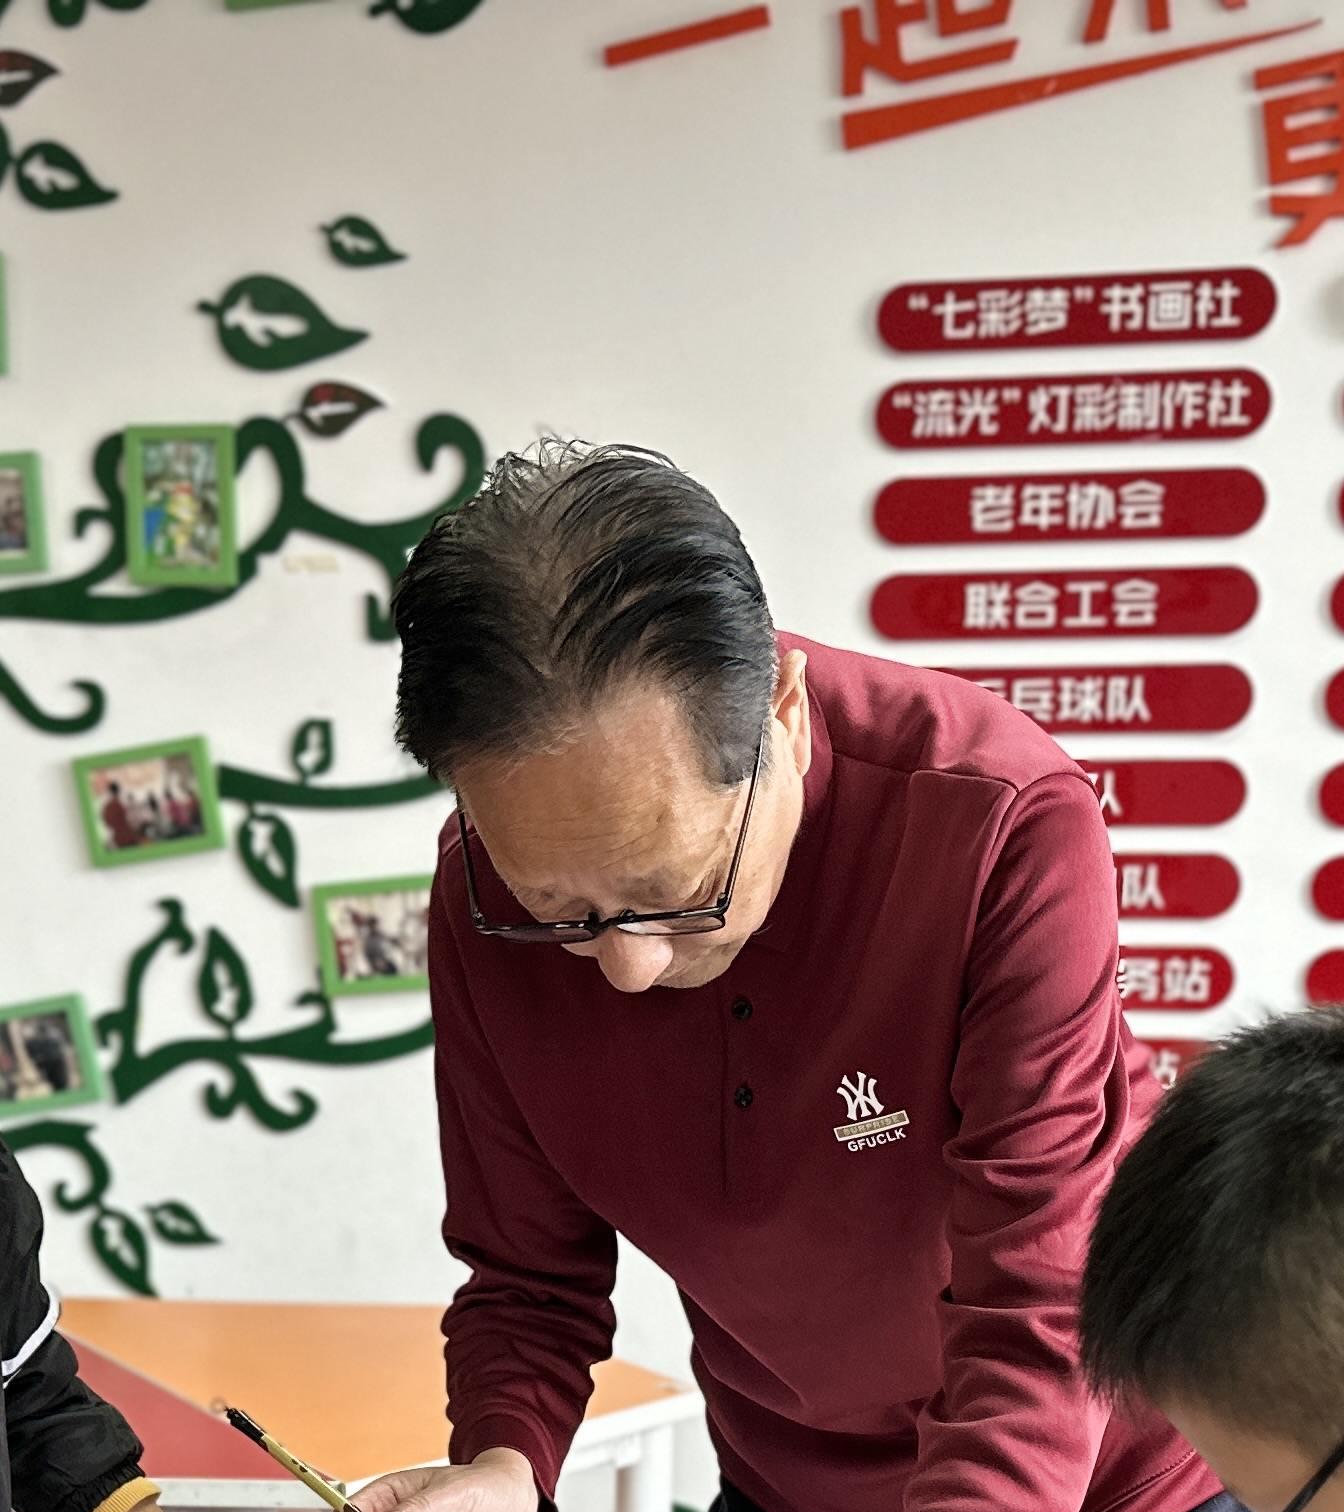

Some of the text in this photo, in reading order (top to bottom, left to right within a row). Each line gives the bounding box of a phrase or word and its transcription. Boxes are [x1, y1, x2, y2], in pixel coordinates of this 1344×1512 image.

[906, 279, 1242, 338] “七彩梦”书画社
[890, 380, 1253, 438] “流光”灯彩制作社
[969, 480, 1165, 532] 老年协会
[963, 580, 1159, 630] 联合工会
[1114, 864, 1166, 910] 队
[846, 1127, 907, 1152] GFUCLK
